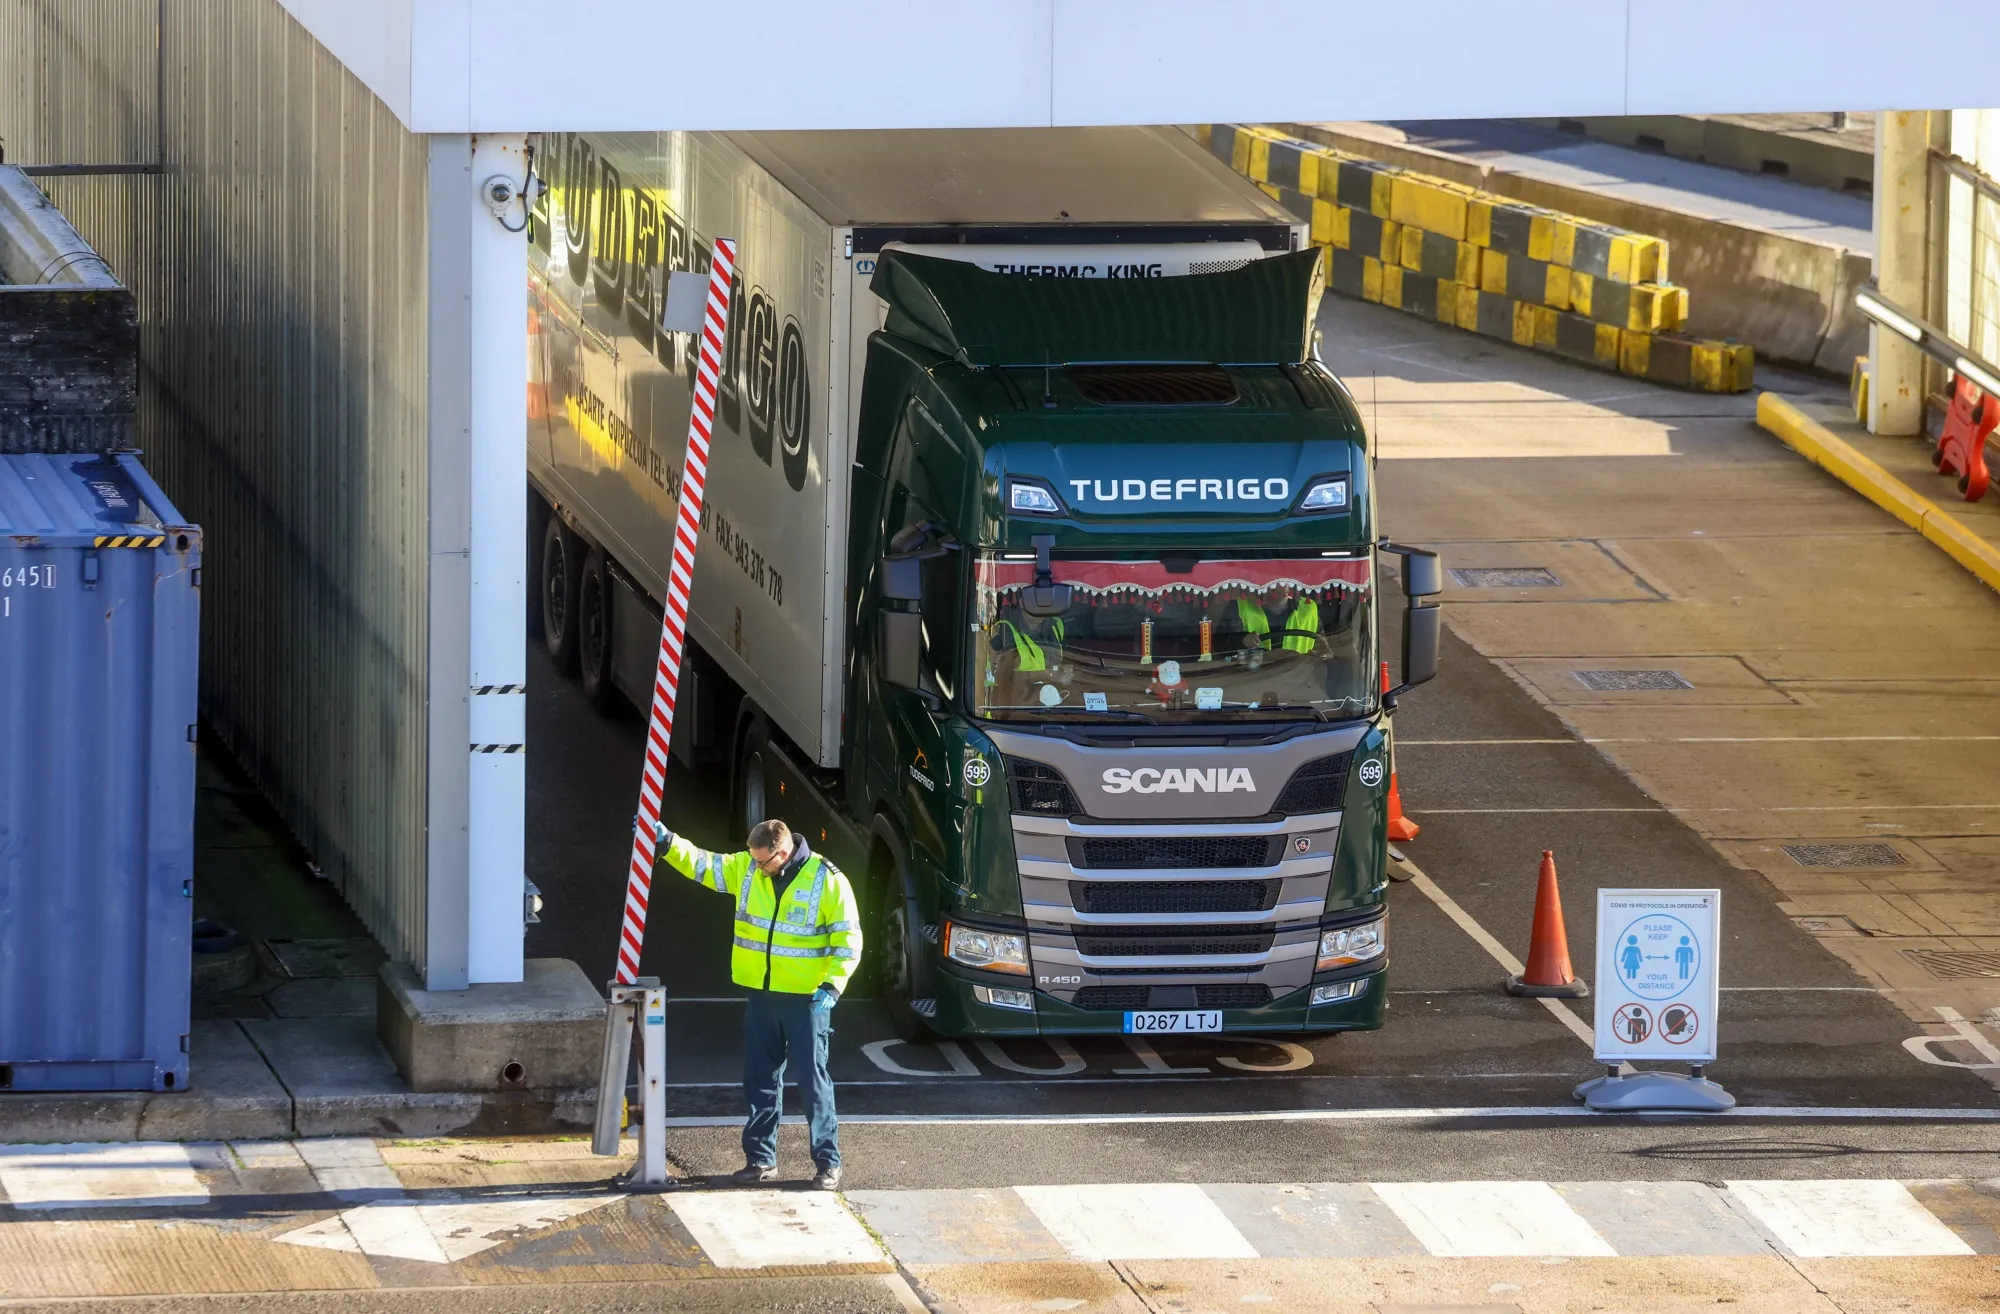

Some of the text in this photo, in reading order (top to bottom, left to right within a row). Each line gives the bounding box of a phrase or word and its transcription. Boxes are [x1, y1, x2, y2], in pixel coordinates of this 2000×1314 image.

[1107, 263, 1162, 279] KING
[576, 378, 605, 432] LASARTE
[608, 409, 648, 475] GUIPUZCOA
[666, 465, 680, 504] 943
[699, 499, 711, 534] 87
[715, 512, 733, 558] FAX:
[735, 532, 749, 574] 943
[750, 548, 764, 589] 376
[768, 565, 783, 607] 778
[1069, 478, 1289, 501] TUDEFRIGO
[909, 764, 935, 792] TUDEFRIGO
[966, 765, 987, 779] 595
[1362, 765, 1381, 780] 595
[1101, 767, 1257, 794] SCANIA
[1643, 924, 1673, 932] PLEASE
[1648, 933, 1669, 941] KEEP
[1039, 975, 1081, 984] R 450
[1646, 973, 1668, 981] YOUR
[1638, 982, 1675, 990] DISTANCE
[1135, 1014, 1179, 1030] 0267
[1185, 1013, 1218, 1030] LTJ
